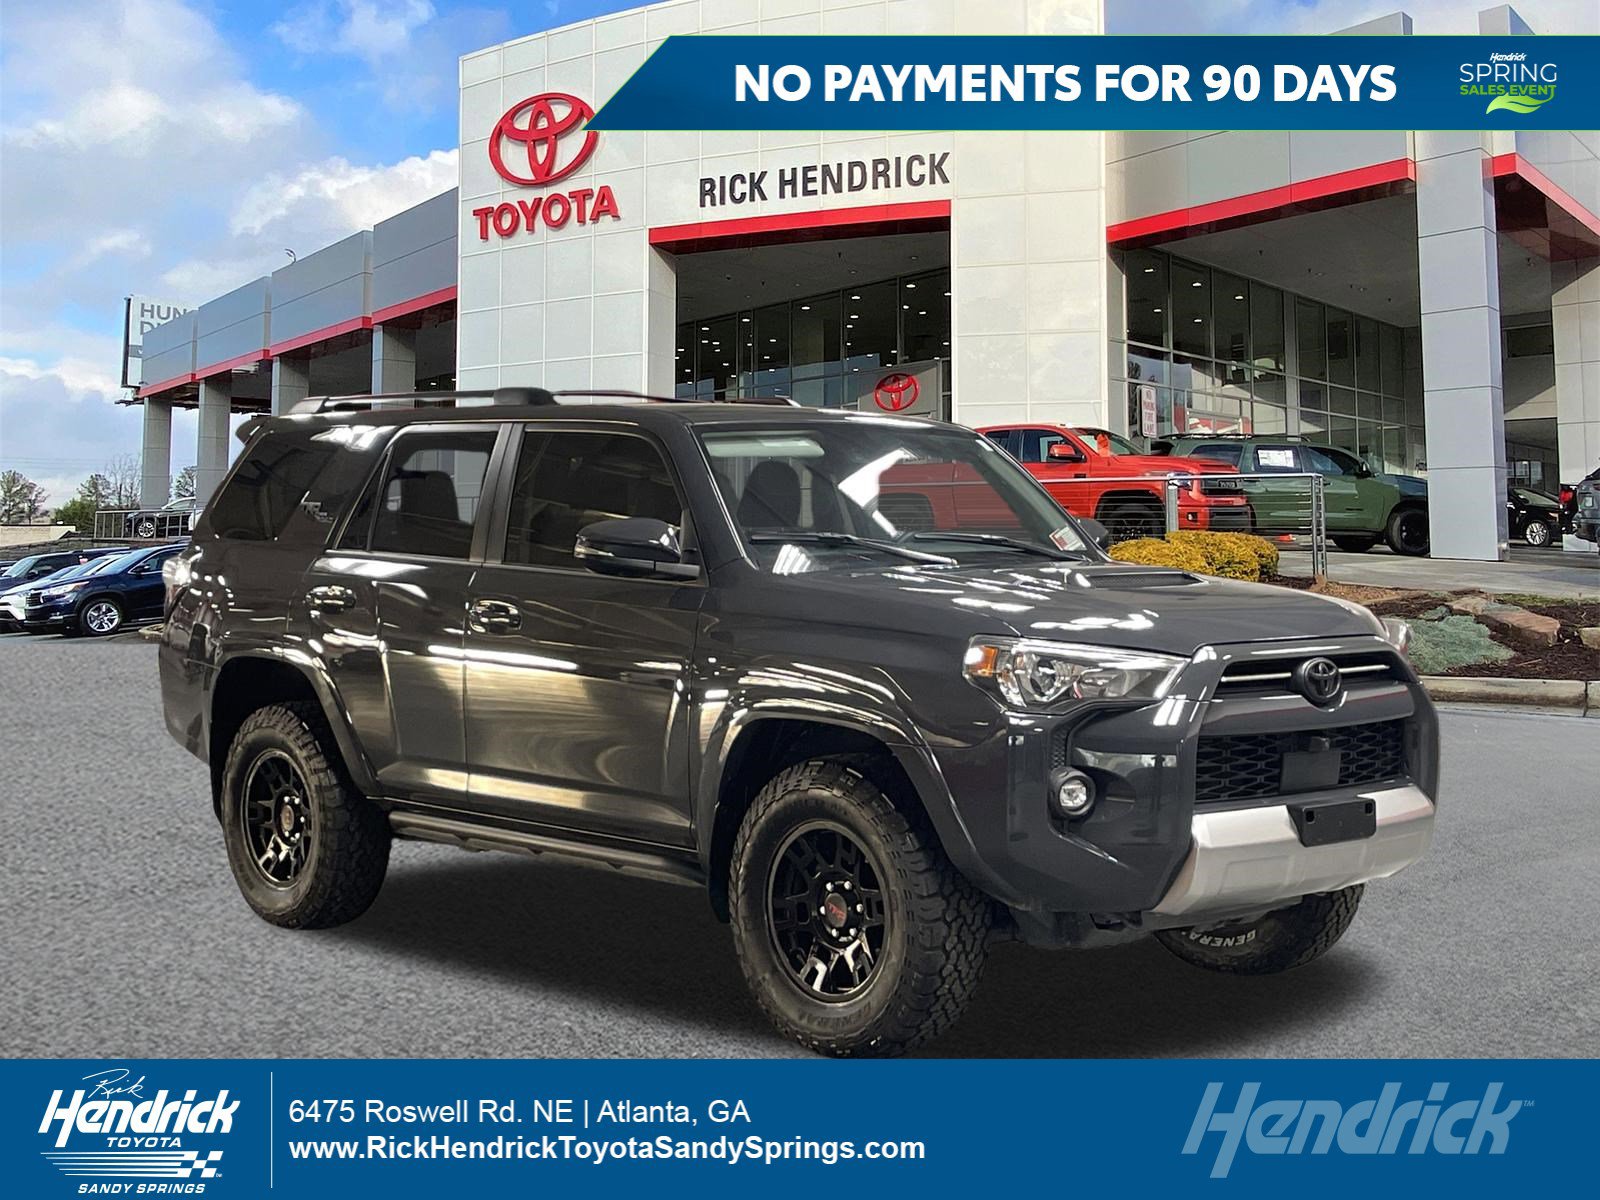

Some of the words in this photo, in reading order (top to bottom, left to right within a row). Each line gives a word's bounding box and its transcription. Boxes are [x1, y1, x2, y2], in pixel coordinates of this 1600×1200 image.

[699, 170, 768, 208] RICK
[778, 151, 951, 199] HENDRICK
[473, 185, 621, 241] TOYOTA
[1182, 929, 1256, 947] GENERA
